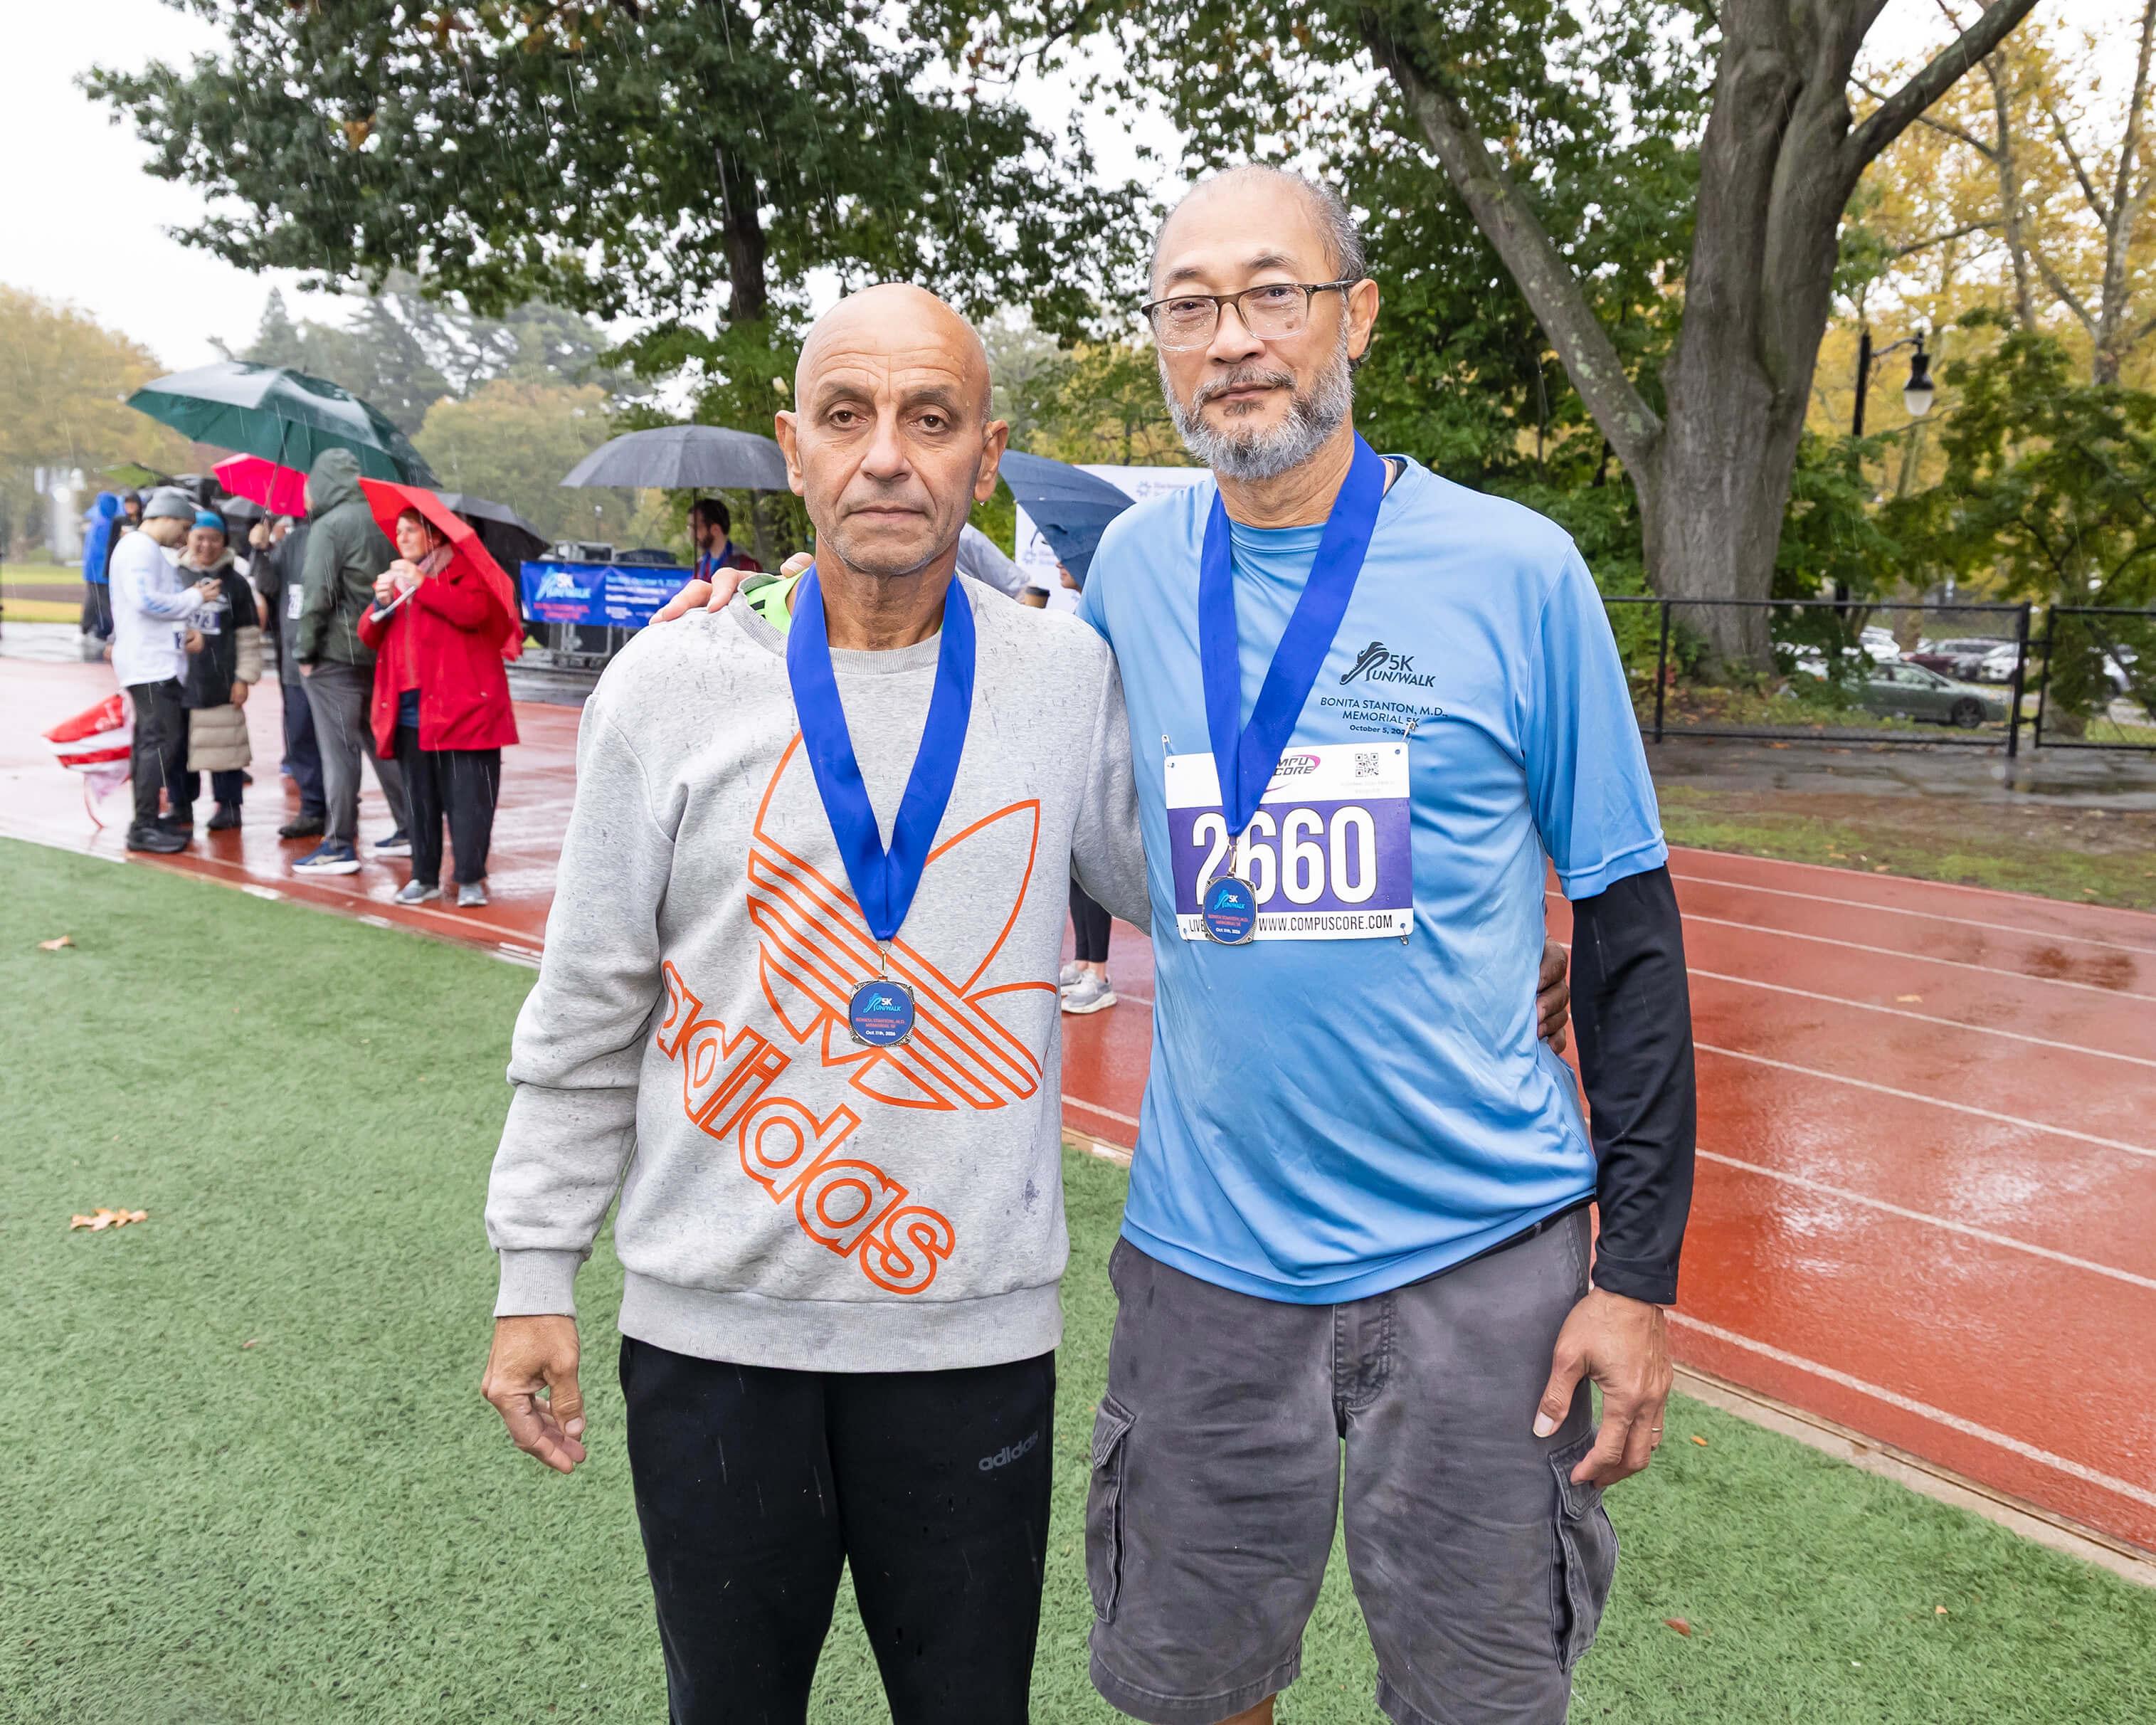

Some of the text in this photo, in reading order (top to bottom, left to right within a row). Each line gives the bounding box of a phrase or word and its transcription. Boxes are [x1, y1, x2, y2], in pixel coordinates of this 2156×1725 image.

[1388, 655, 1415, 672] 5K
[1320, 697, 1360, 708] BONITA
[1363, 700, 1417, 715] STANTON,
[1342, 710, 1404, 724] MEMORIAL
[1349, 724, 1380, 734] October
[1192, 805, 1378, 906] 2660
[1259, 914, 1393, 932] WWW.COMPUSCORE.COM
[881, 997, 892, 1006] 5K
[657, 959, 956, 1296] adidas
